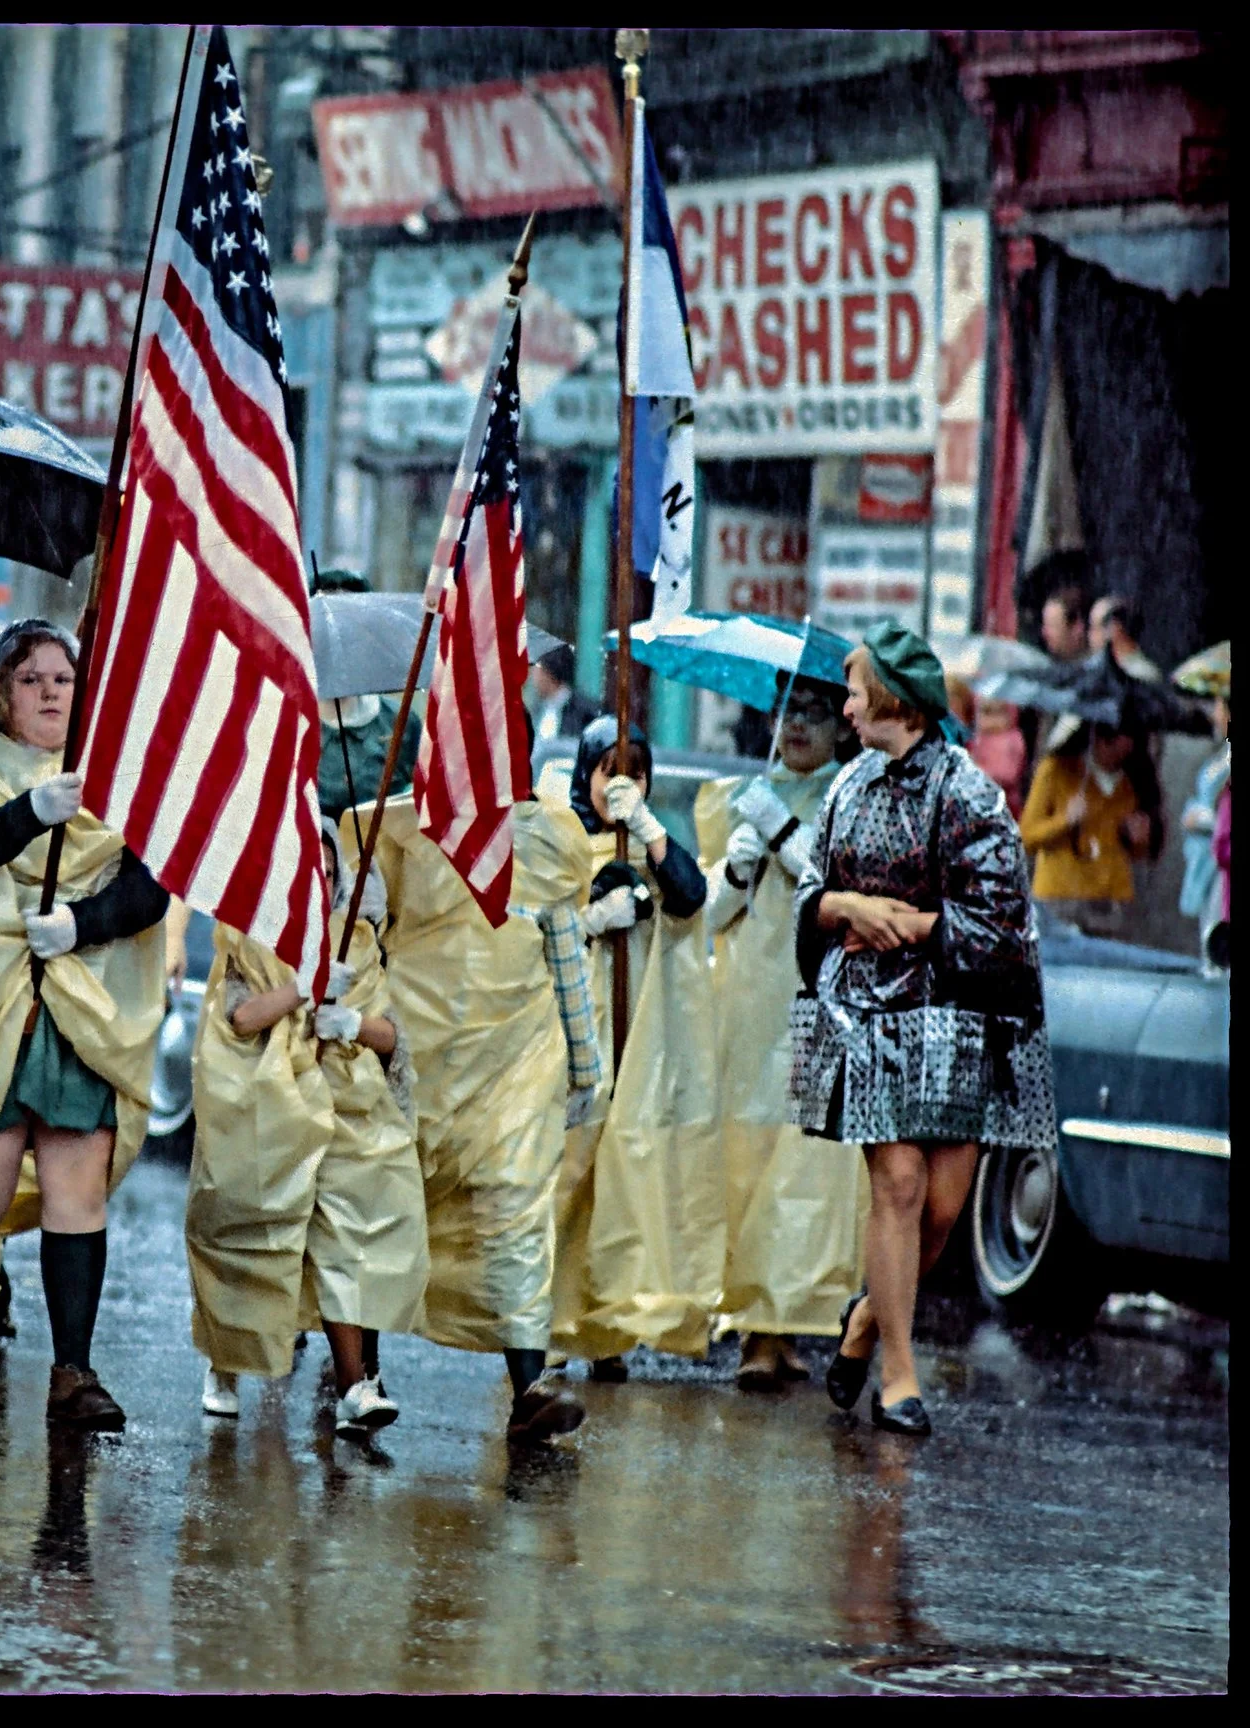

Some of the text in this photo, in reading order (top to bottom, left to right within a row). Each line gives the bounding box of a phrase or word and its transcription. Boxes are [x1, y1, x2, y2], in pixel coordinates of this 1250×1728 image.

[676, 184, 917, 293] CHECKS
[687, 291, 923, 391] CASHED
[700, 396, 921, 436] ONEY ORDERS
